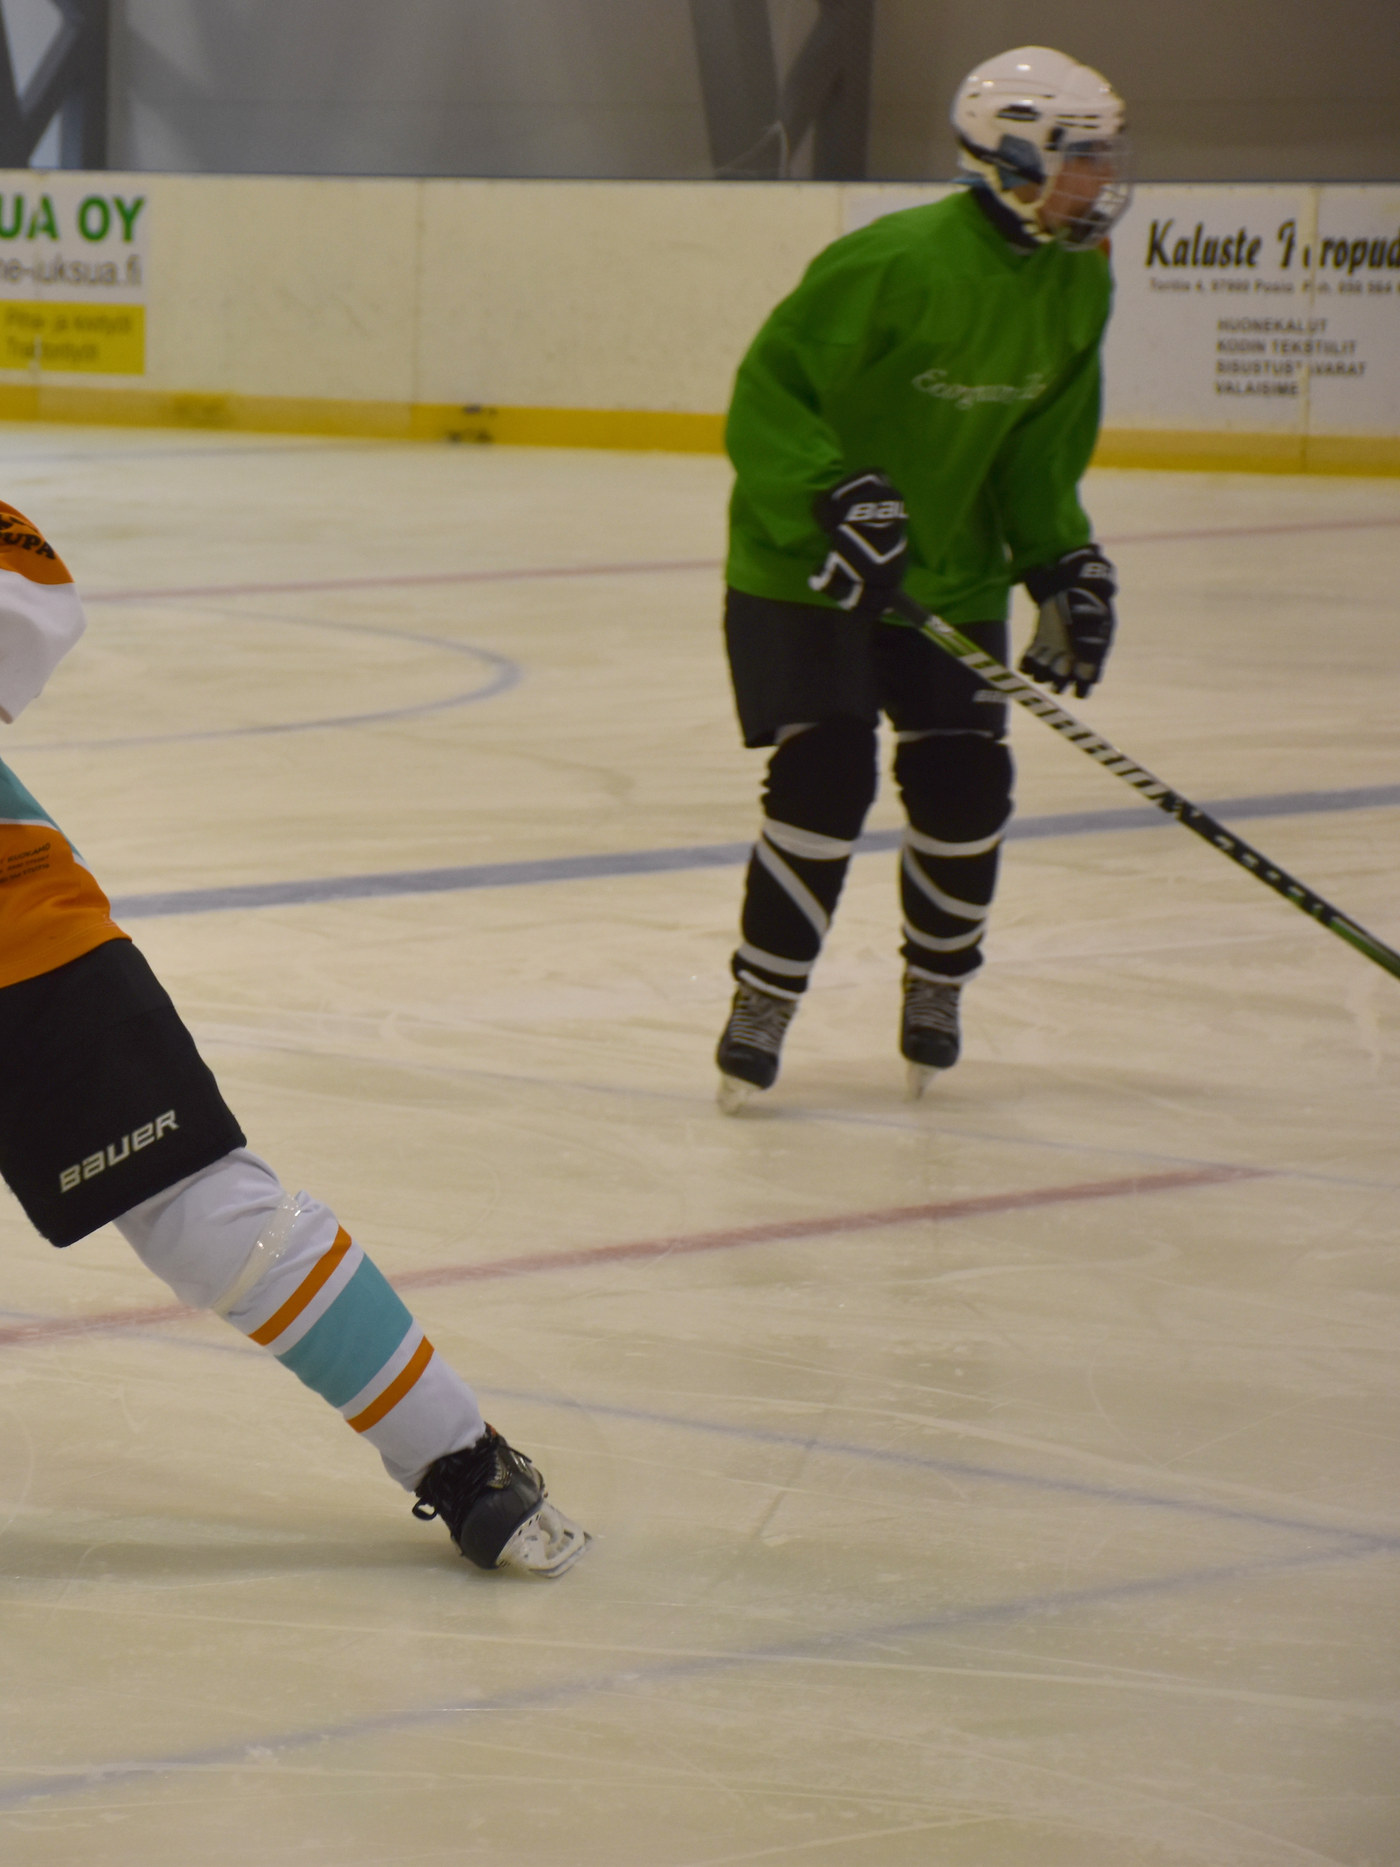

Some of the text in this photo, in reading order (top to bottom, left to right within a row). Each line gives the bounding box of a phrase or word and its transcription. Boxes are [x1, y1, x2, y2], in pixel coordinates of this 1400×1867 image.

[77, 196, 145, 243] OY
[1145, 218, 1262, 268] Kaluste
[58, 1109, 180, 1194] BAUER
